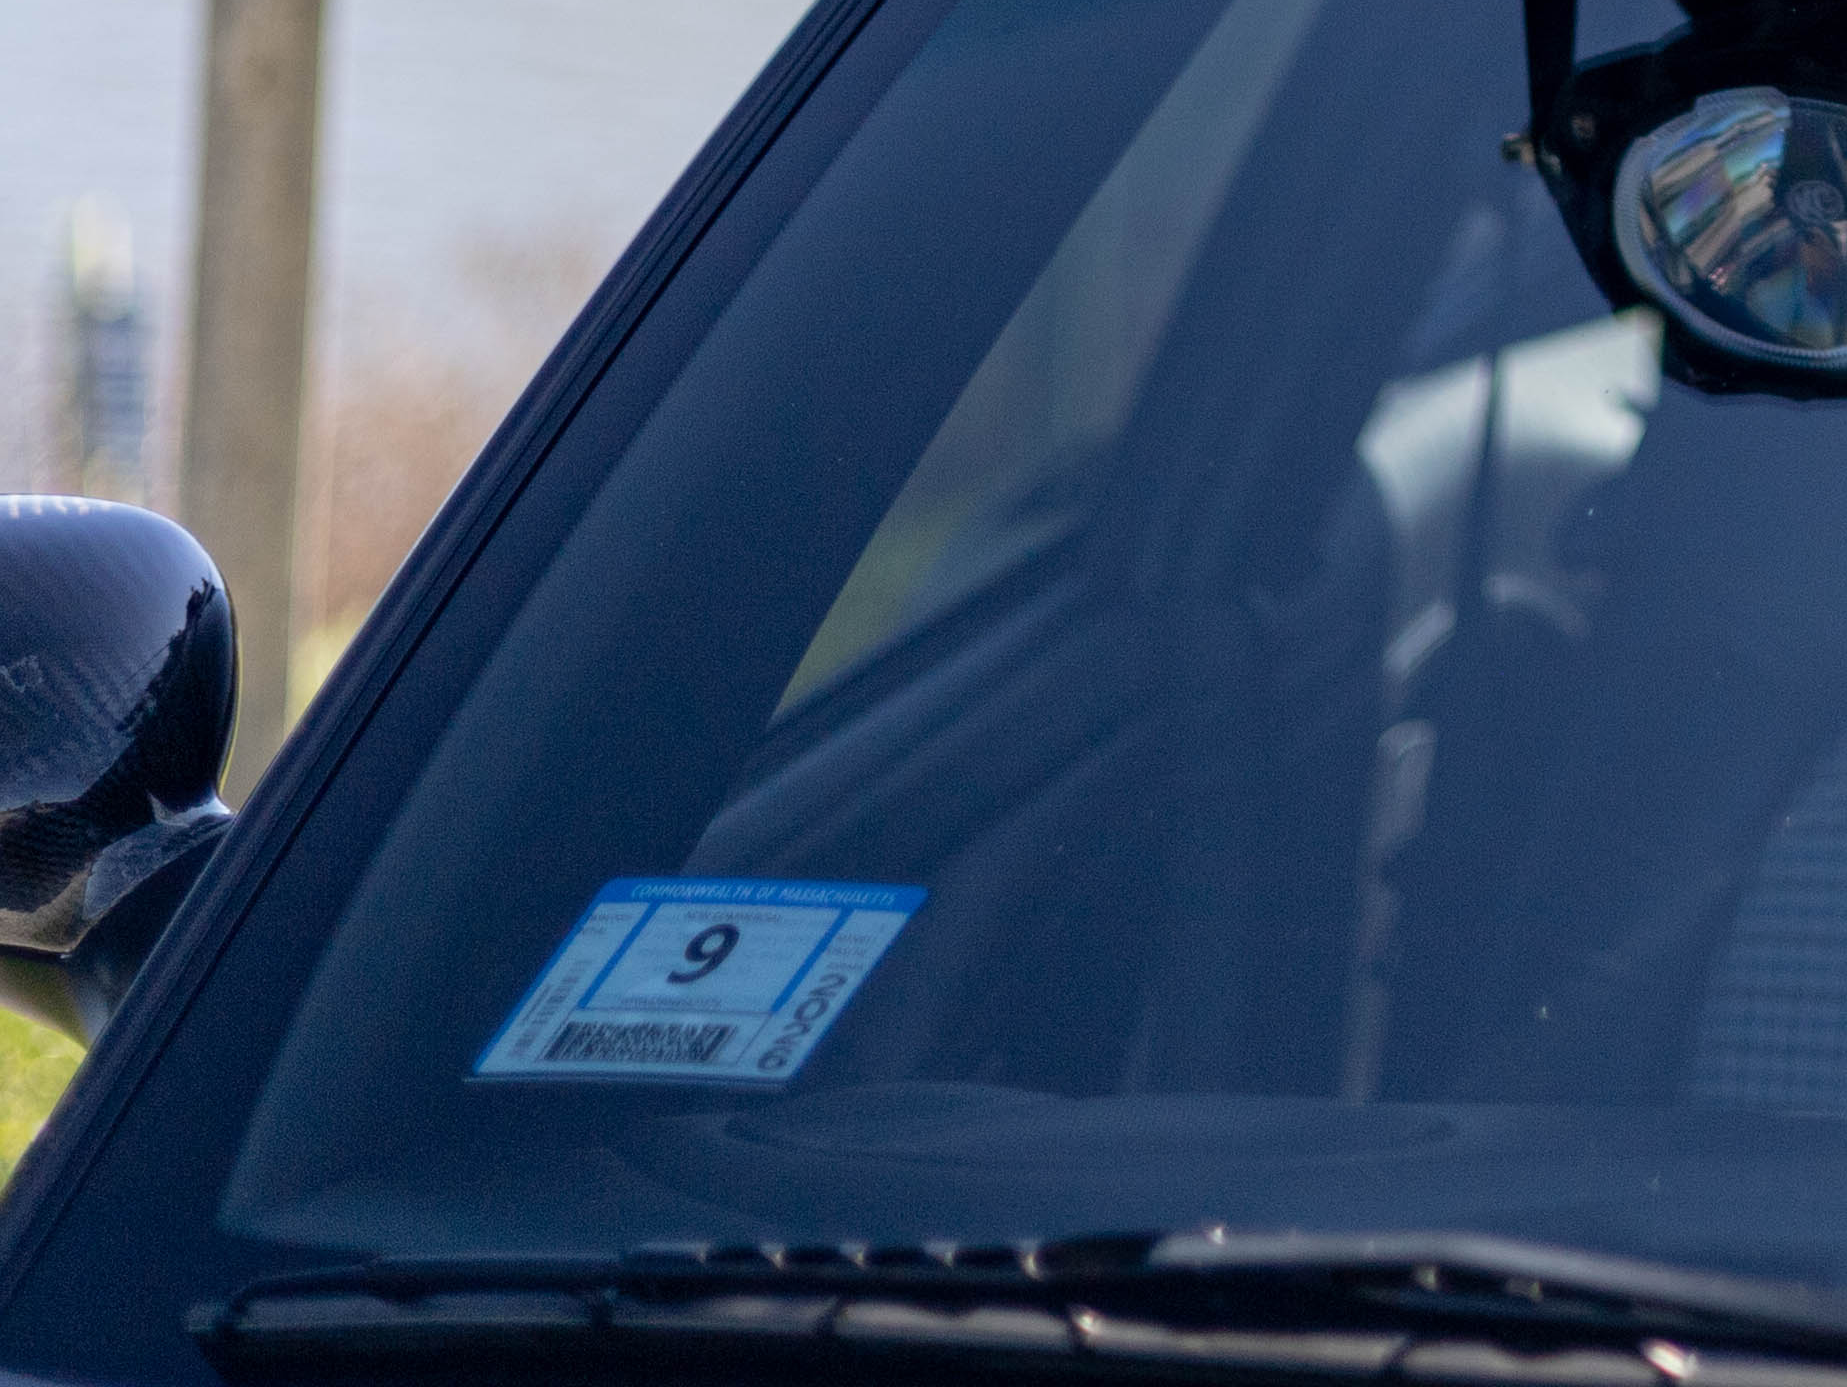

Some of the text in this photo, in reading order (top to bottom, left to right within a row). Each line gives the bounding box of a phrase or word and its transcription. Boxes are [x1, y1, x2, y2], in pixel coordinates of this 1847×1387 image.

[631, 883, 752, 900] COMMONWEALTH
[755, 885, 777, 900] OF
[665, 923, 740, 985] 9
[757, 973, 848, 1070] 2026
